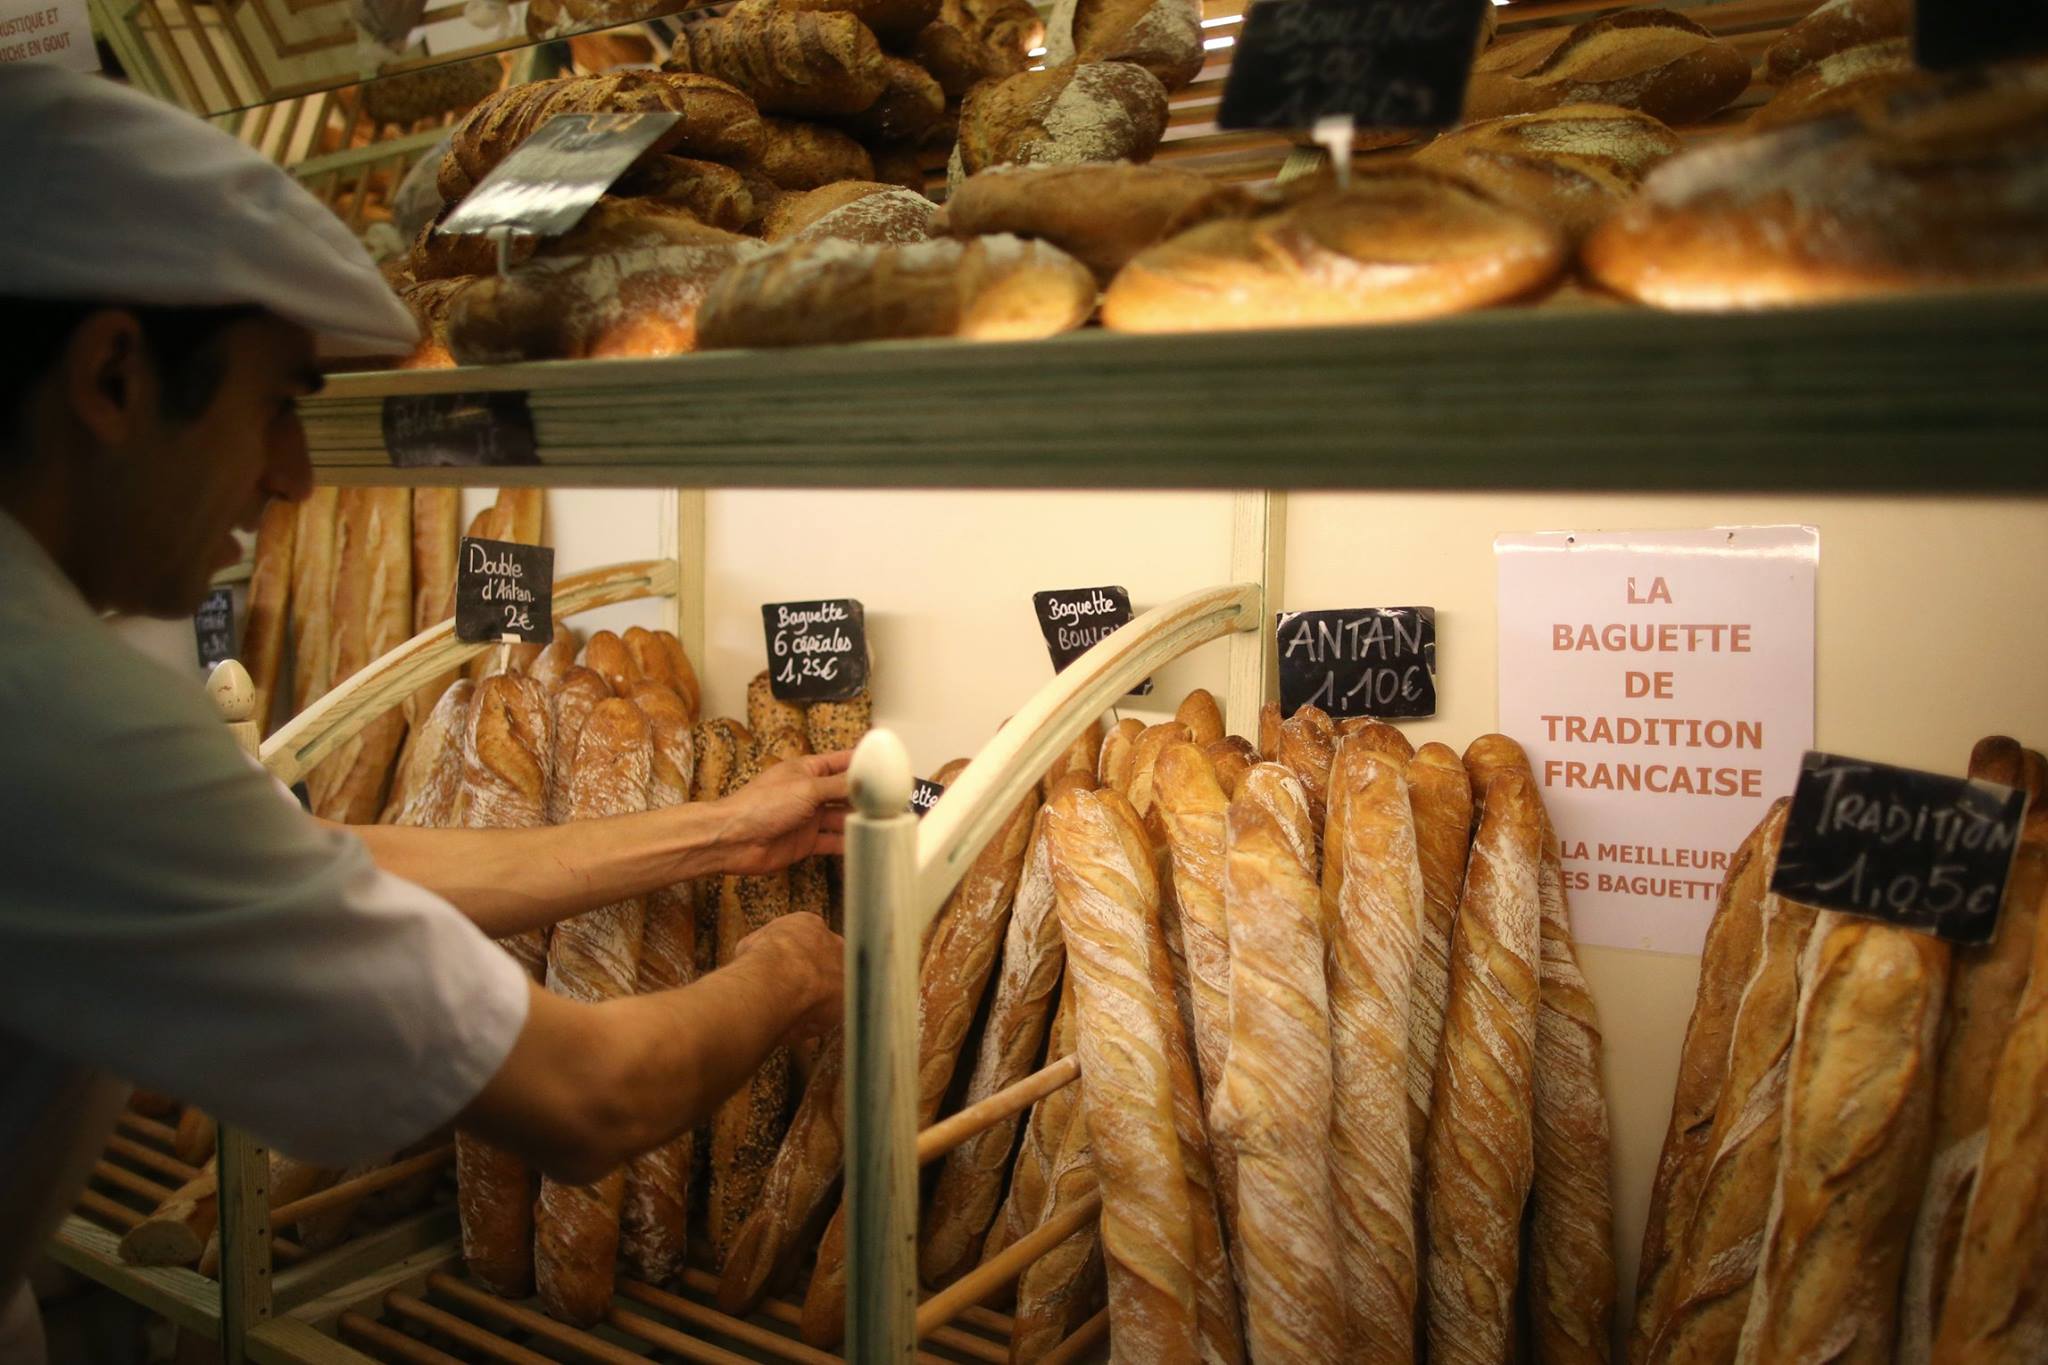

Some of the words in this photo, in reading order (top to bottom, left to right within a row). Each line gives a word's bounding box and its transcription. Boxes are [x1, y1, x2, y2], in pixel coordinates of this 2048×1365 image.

[46, 7, 59, 26] ET
[28, 39, 42, 57] EN
[42, 31, 71, 53] GOUT
[1627, 576, 1673, 604] LA
[504, 604, 534, 631] 2€
[777, 602, 848, 636] Baguette
[1048, 590, 1117, 627] Baguette
[774, 629, 788, 657] 6
[1058, 623, 1120, 651] BOULE
[1284, 616, 1422, 662] ANTAN
[1552, 623, 1751, 652] BAGUETTE
[776, 656, 838, 686] 1,25€
[1625, 671, 1674, 699] DE
[1302, 665, 1423, 710] 1,10€
[1541, 715, 1762, 749] TRADITION
[1544, 760, 1762, 798] FRANCAISE
[912, 784, 938, 808] ette
[1561, 840, 1590, 860] LA
[1561, 870, 1590, 890] ES
